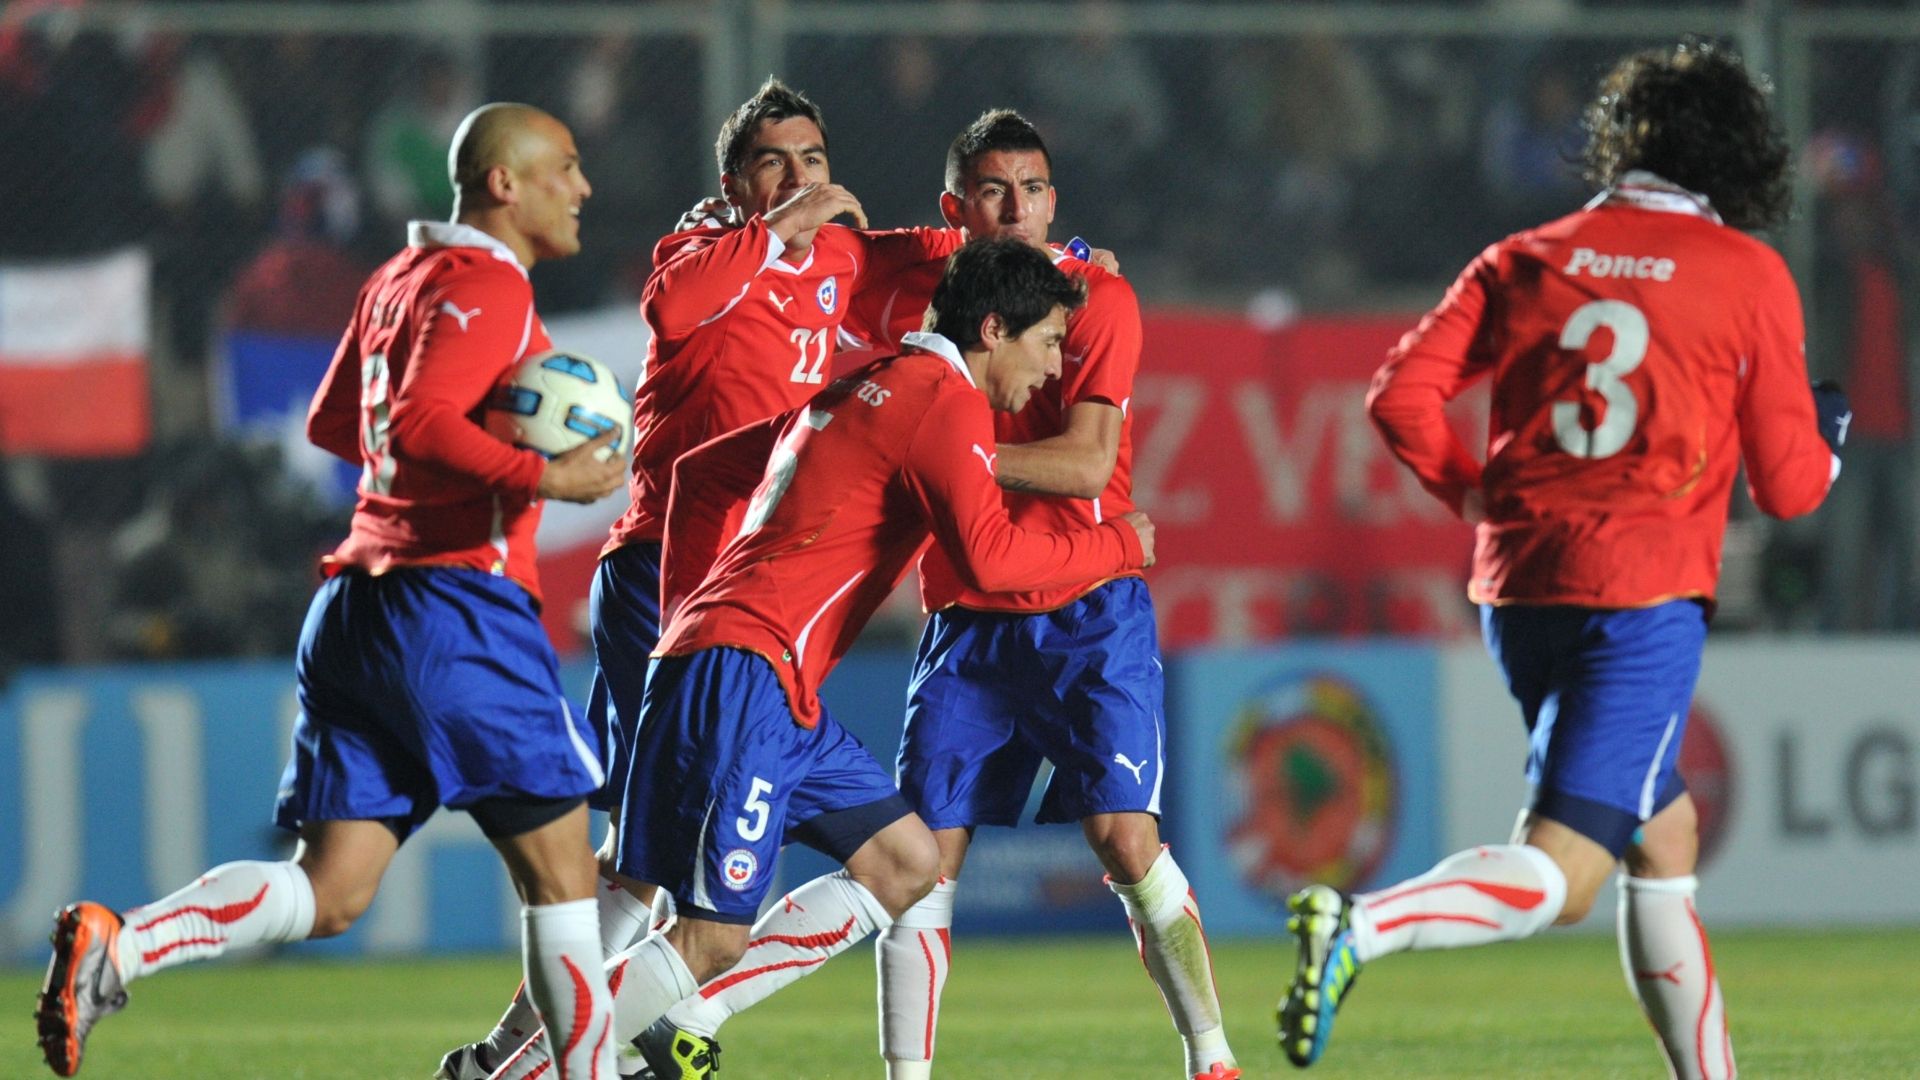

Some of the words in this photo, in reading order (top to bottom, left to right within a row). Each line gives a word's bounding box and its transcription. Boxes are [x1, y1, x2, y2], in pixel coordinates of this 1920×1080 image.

[1563, 248, 1676, 282] Ponce
[1552, 299, 1650, 460] 3
[736, 776, 773, 842] 5
[1776, 724, 1919, 841] LG
